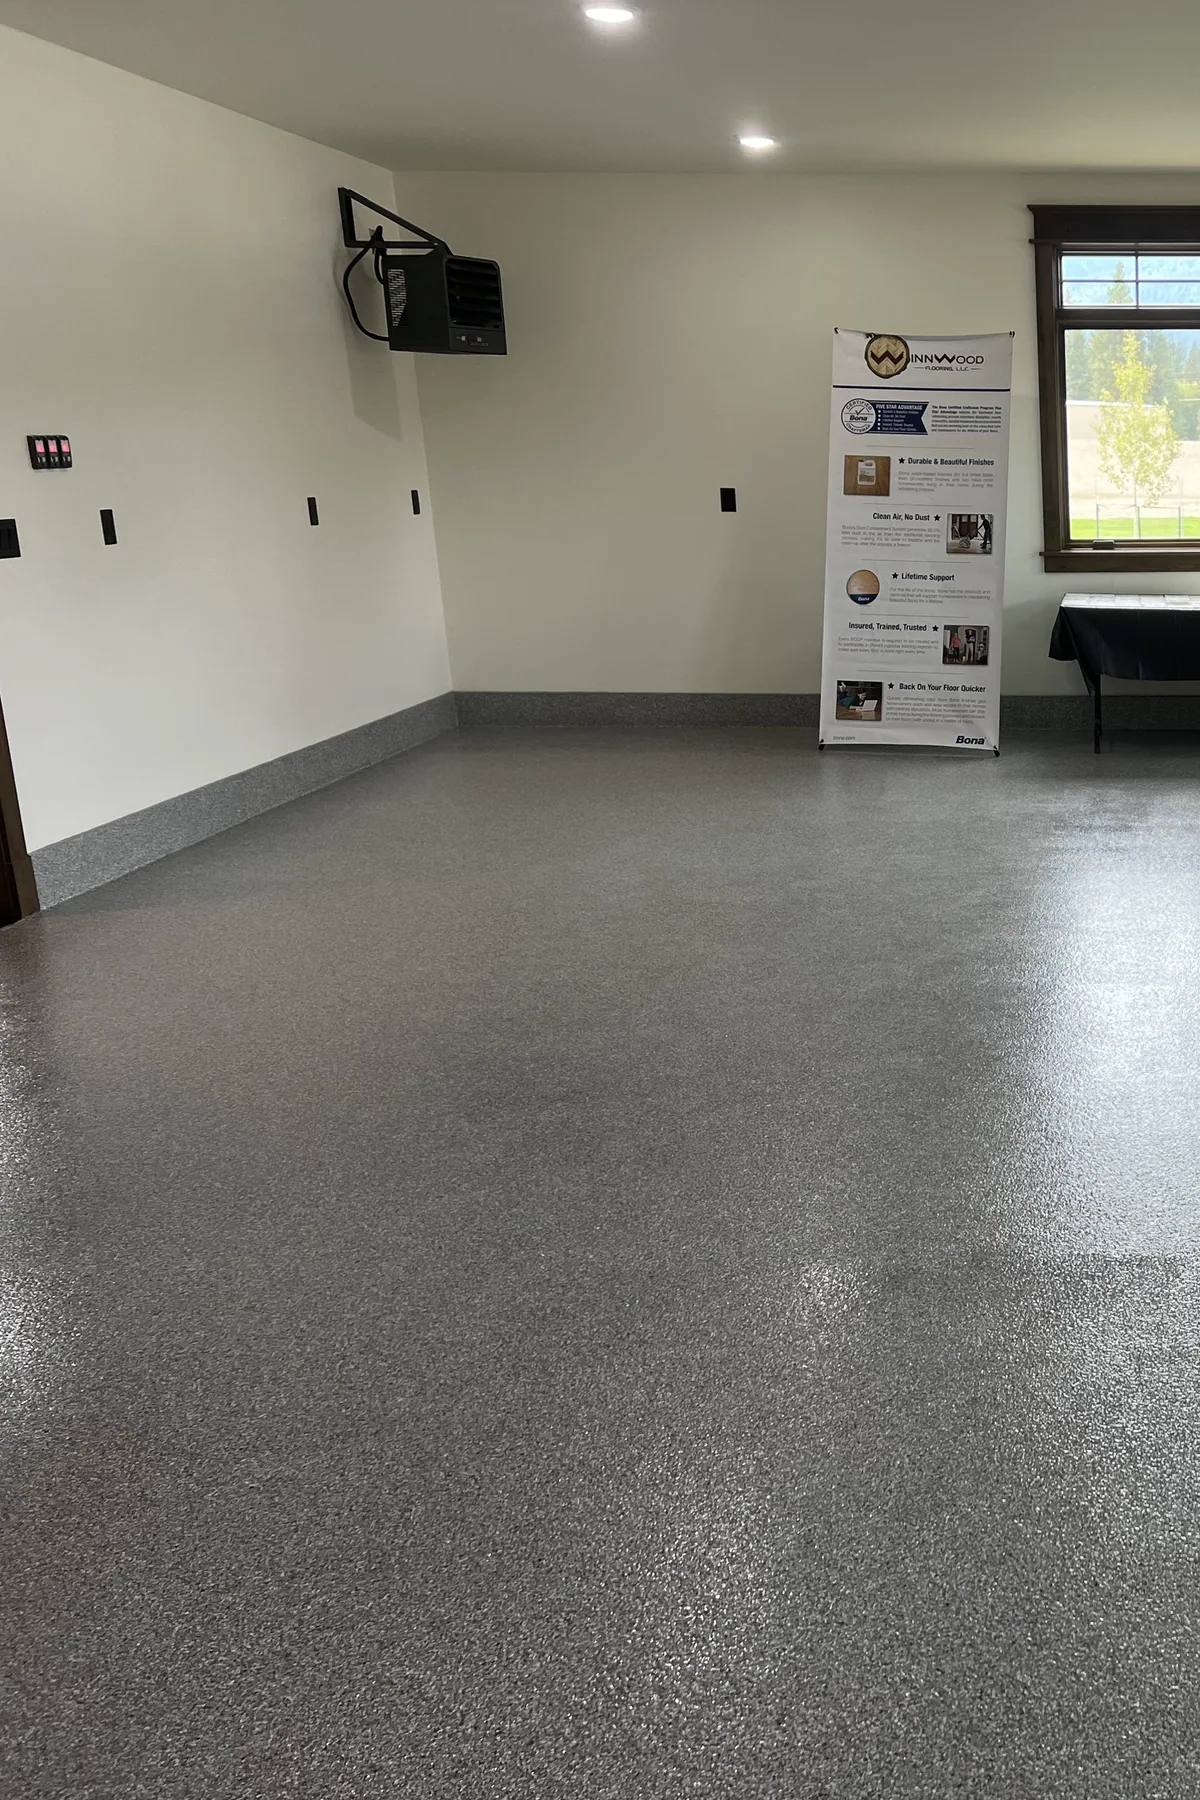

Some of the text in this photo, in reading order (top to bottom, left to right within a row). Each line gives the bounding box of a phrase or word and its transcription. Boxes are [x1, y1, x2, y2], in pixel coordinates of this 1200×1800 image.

[908, 457, 932, 465] Durable
[893, 513, 903, 521] Air,
[929, 574, 955, 582] Support
[849, 622, 875, 630] Insured,
[876, 623, 901, 631] Trained,
[961, 685, 986, 693] Quicker
[956, 736, 985, 745] Bona
